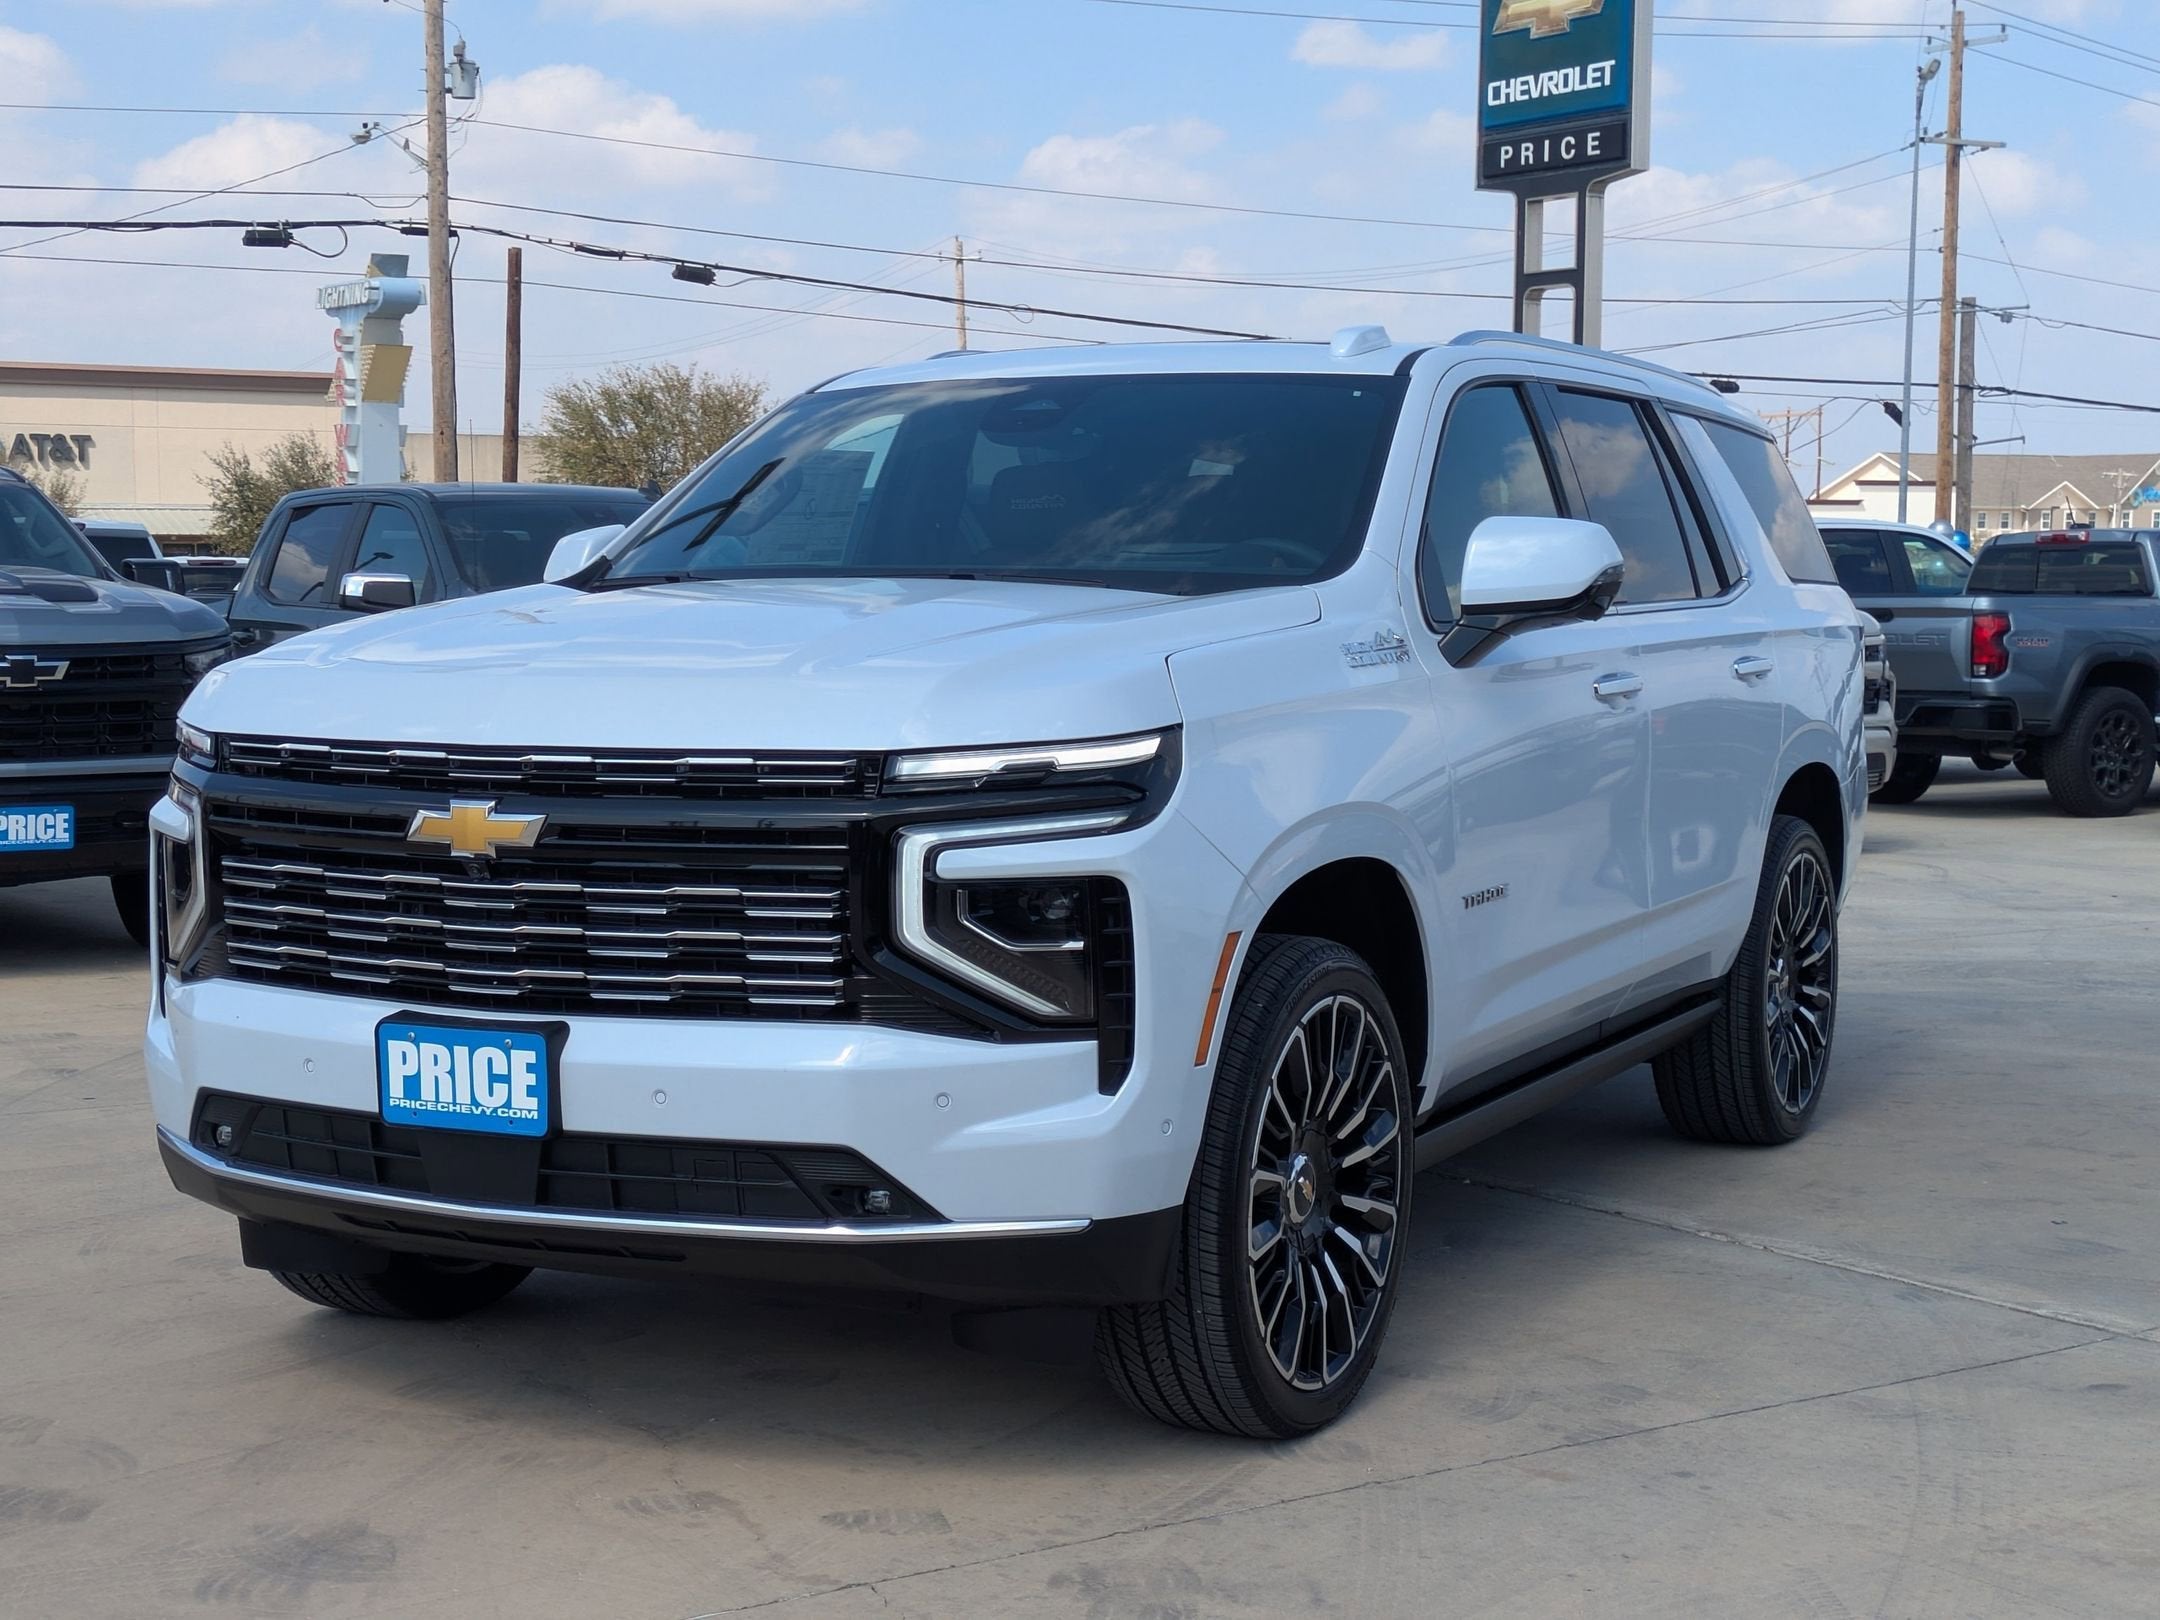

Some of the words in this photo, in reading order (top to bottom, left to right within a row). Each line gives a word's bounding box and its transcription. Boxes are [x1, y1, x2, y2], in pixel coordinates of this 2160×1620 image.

[1487, 60, 1616, 106] CHEVROLET
[1500, 132, 1601, 169] PRICE
[316, 279, 370, 309] LIGHTNING
[8, 433, 93, 463] AT&T
[387, 1039, 539, 1110] PRICE
[389, 1098, 539, 1120] PRICECHEVY.COM
